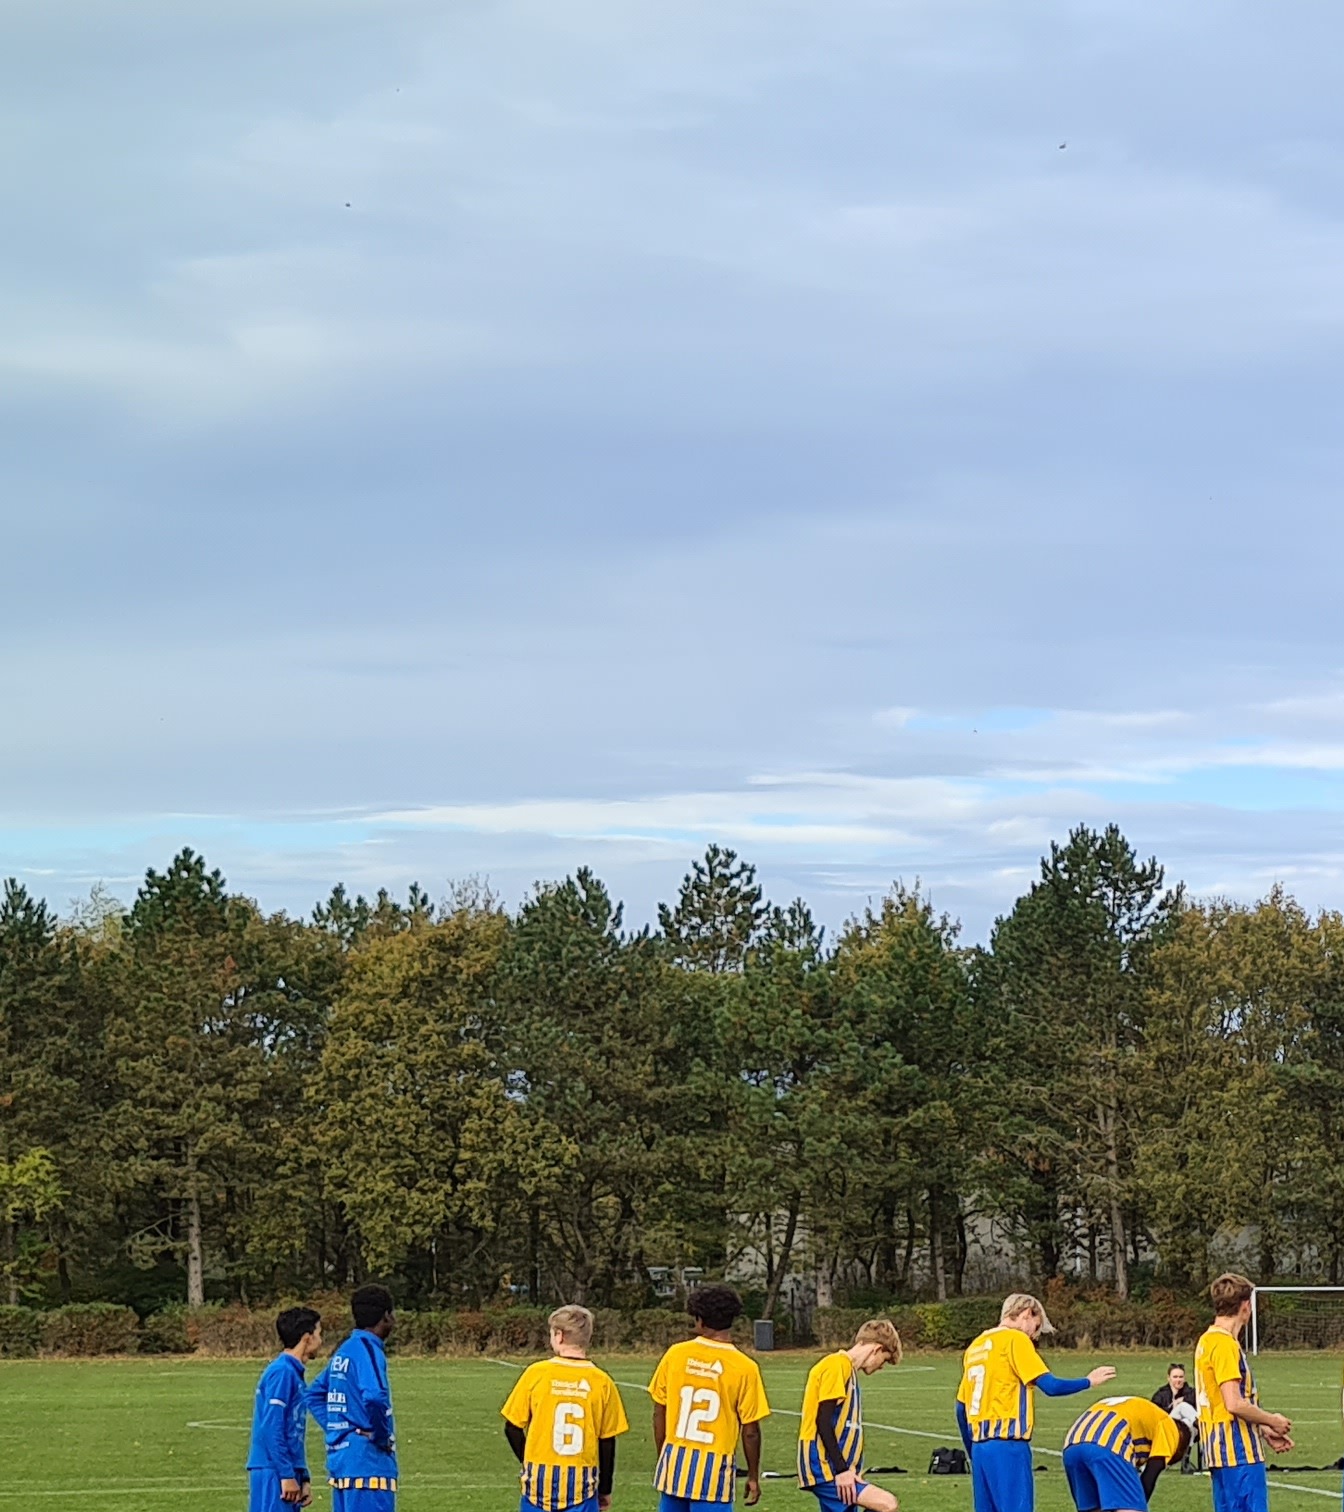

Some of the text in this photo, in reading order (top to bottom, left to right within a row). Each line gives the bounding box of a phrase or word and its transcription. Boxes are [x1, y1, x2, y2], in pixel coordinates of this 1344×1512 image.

[675, 1385, 721, 1444] 12
[967, 1364, 986, 1416] 7
[552, 1402, 585, 1456] 6
